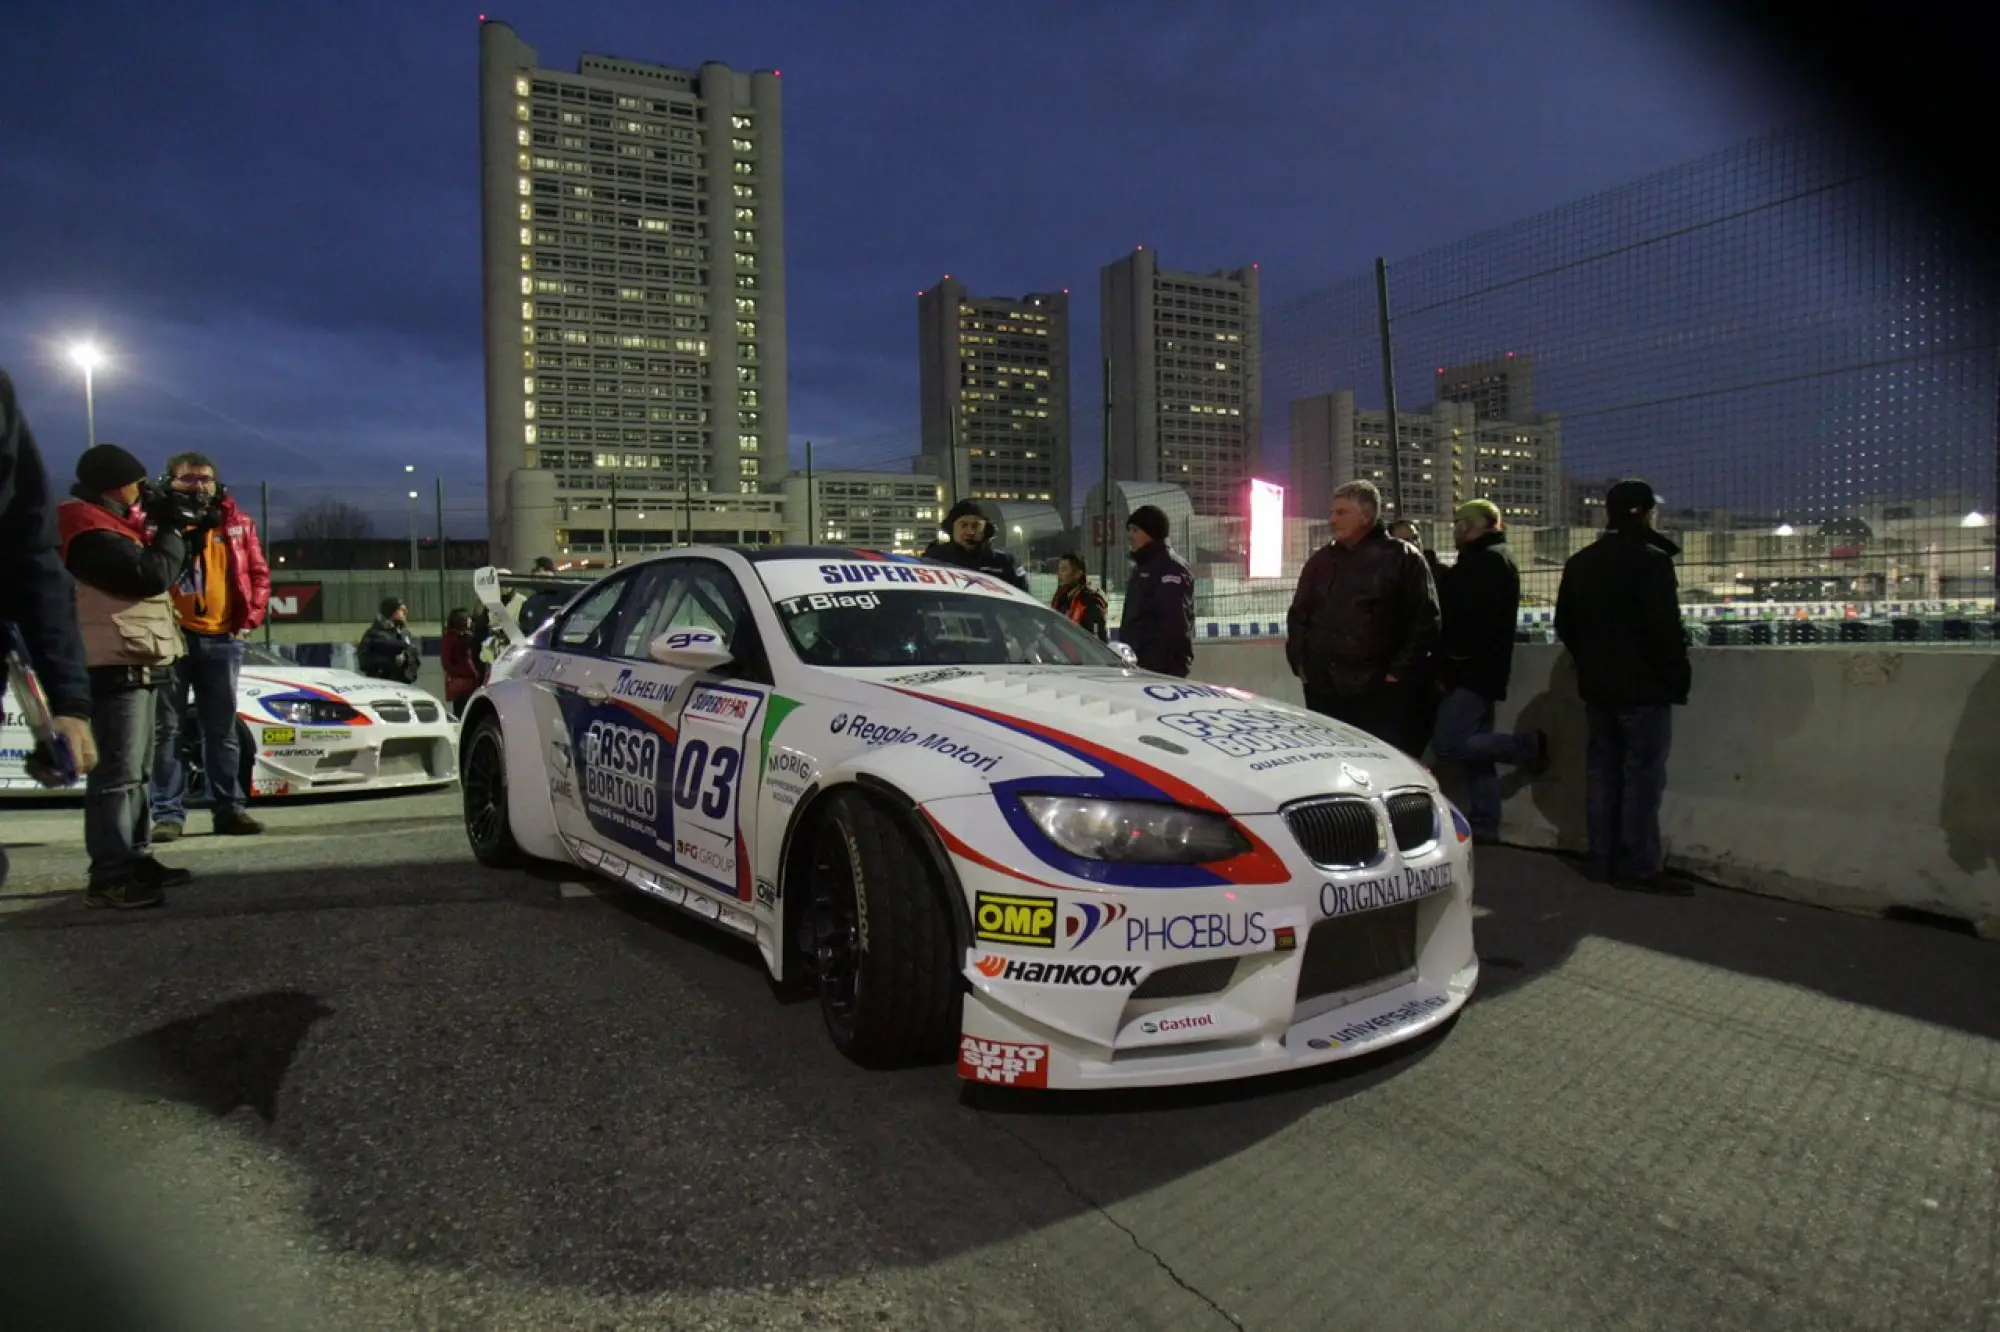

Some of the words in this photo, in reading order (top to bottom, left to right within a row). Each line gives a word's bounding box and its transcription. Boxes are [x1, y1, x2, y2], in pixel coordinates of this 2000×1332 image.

[781, 591, 882, 616] T.Biagi
[847, 714, 918, 745] Reggio
[917, 732, 1003, 773] Motori
[674, 739, 740, 819] 03
[1320, 876, 1405, 916] ORIGINAL
[1404, 862, 1453, 898] PARQUET
[977, 903, 1054, 935] OMP
[1159, 1014, 1214, 1031] Castrol
[961, 1037, 1045, 1060] AUTO
[963, 1051, 1037, 1073] SPRI
[976, 1066, 1021, 1083] NT
